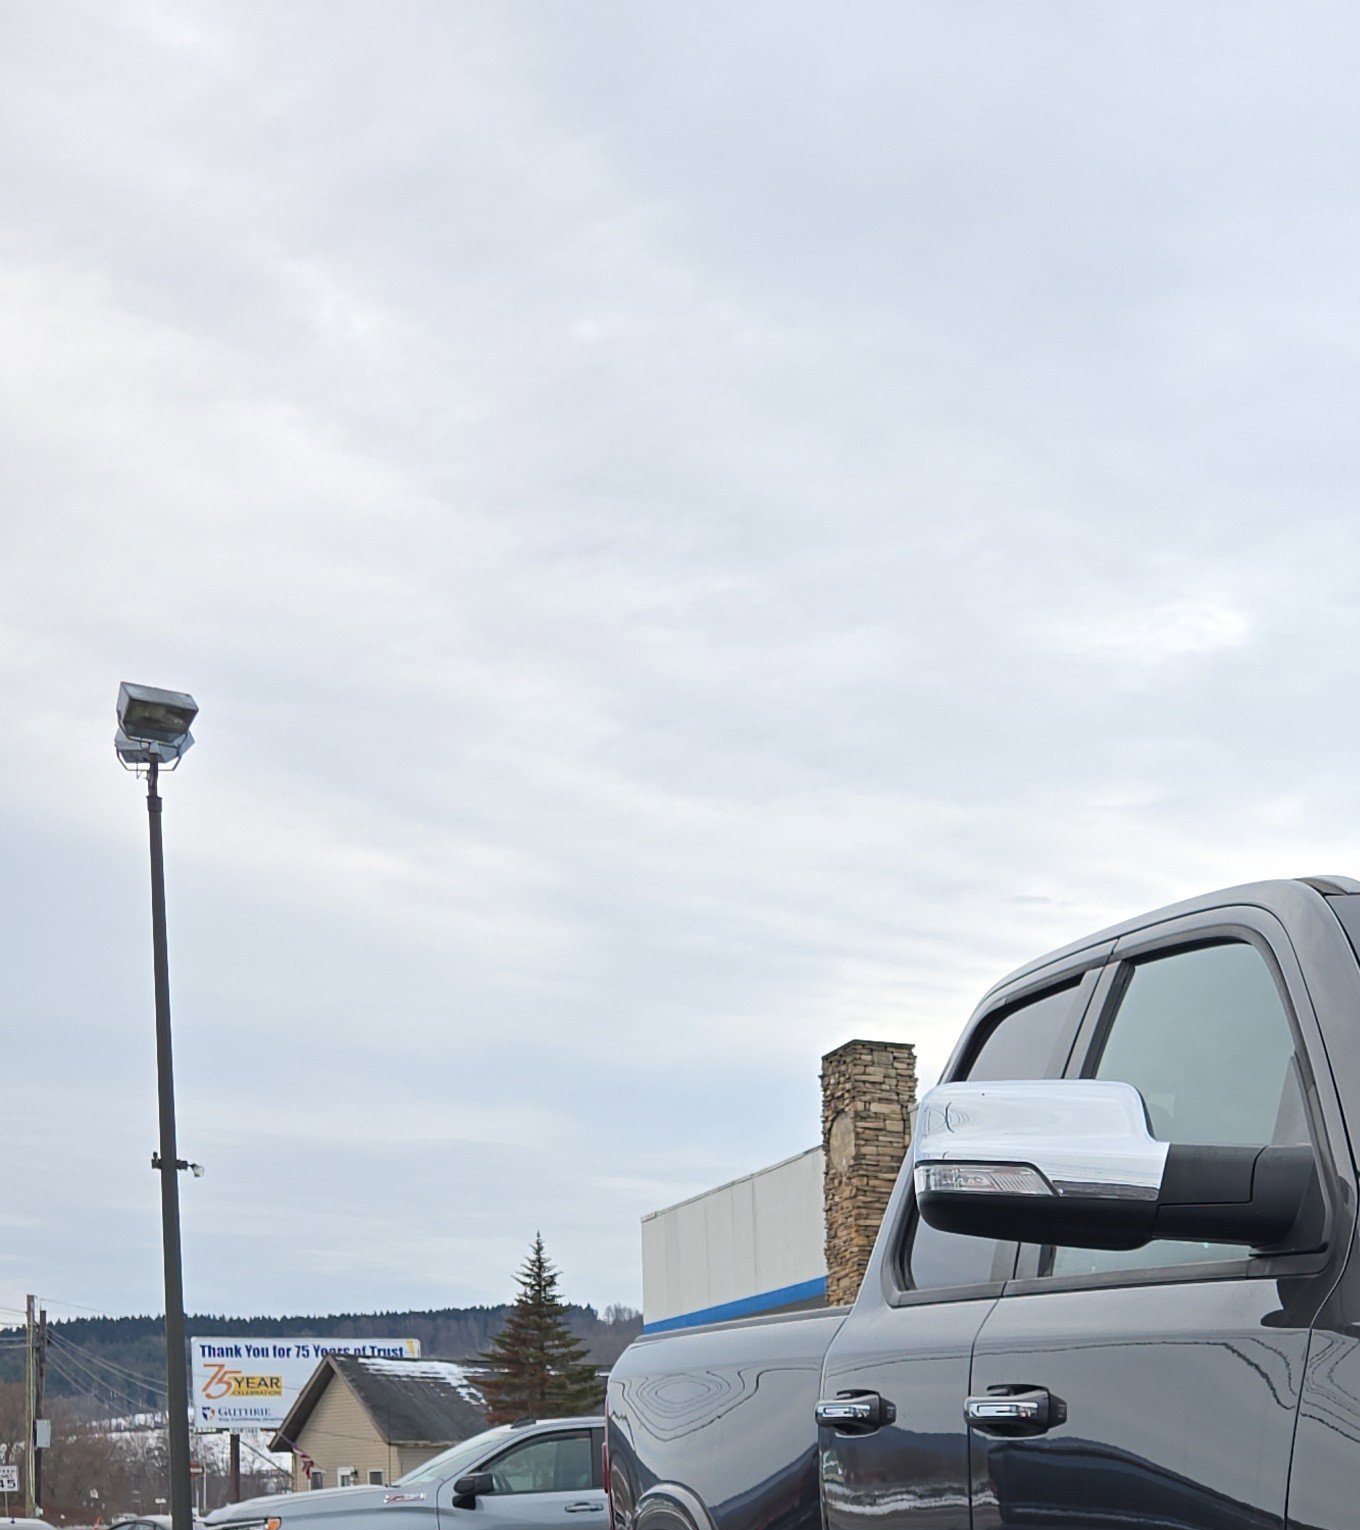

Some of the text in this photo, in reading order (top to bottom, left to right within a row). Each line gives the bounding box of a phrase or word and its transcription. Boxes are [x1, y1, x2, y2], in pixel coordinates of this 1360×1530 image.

[199, 1343, 242, 1359] Thank
[244, 1344, 268, 1359] You
[272, 1344, 292, 1359] for
[295, 1345, 310, 1359] 75
[369, 1345, 403, 1358] Trust
[202, 1363, 242, 1400] 75
[233, 1376, 281, 1389] YEAR
